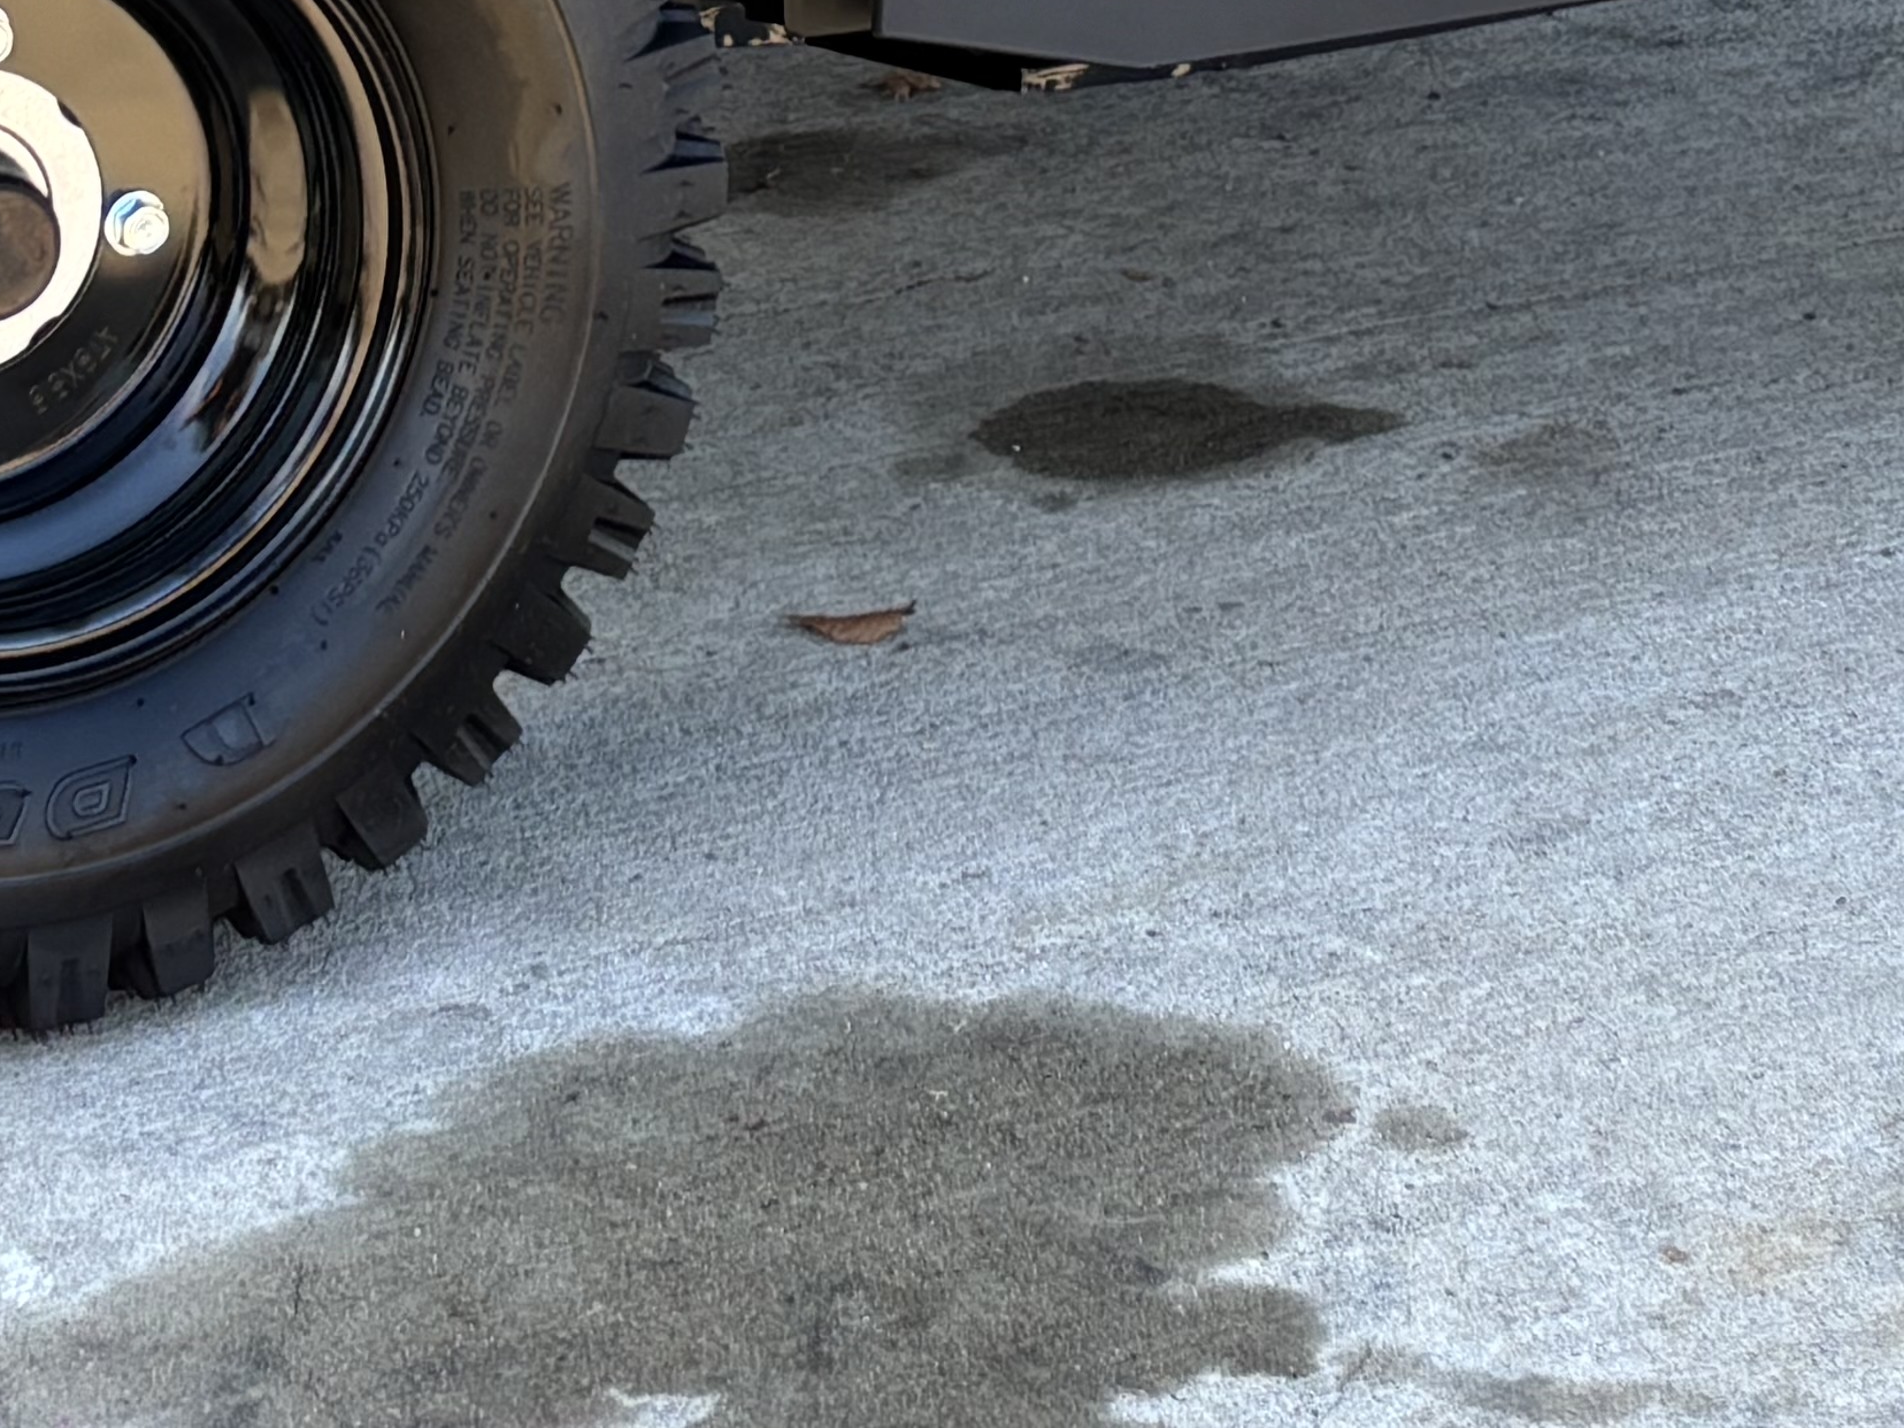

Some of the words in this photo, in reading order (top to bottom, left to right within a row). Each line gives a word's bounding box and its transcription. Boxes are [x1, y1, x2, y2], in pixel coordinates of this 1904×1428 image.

[458, 190, 476, 246] WHEN
[480, 188, 498, 216] DO
[502, 188, 522, 228] FOR
[524, 186, 543, 225] SEE
[514, 240, 542, 336] VEHICLE
[539, 182, 571, 327] WARNING
[442, 256, 474, 350] SEATING
[459, 284, 492, 375] INFLATE
[484, 240, 520, 360] OPERATING
[424, 384, 470, 466] BEYOND
[478, 419, 503, 448] OR
